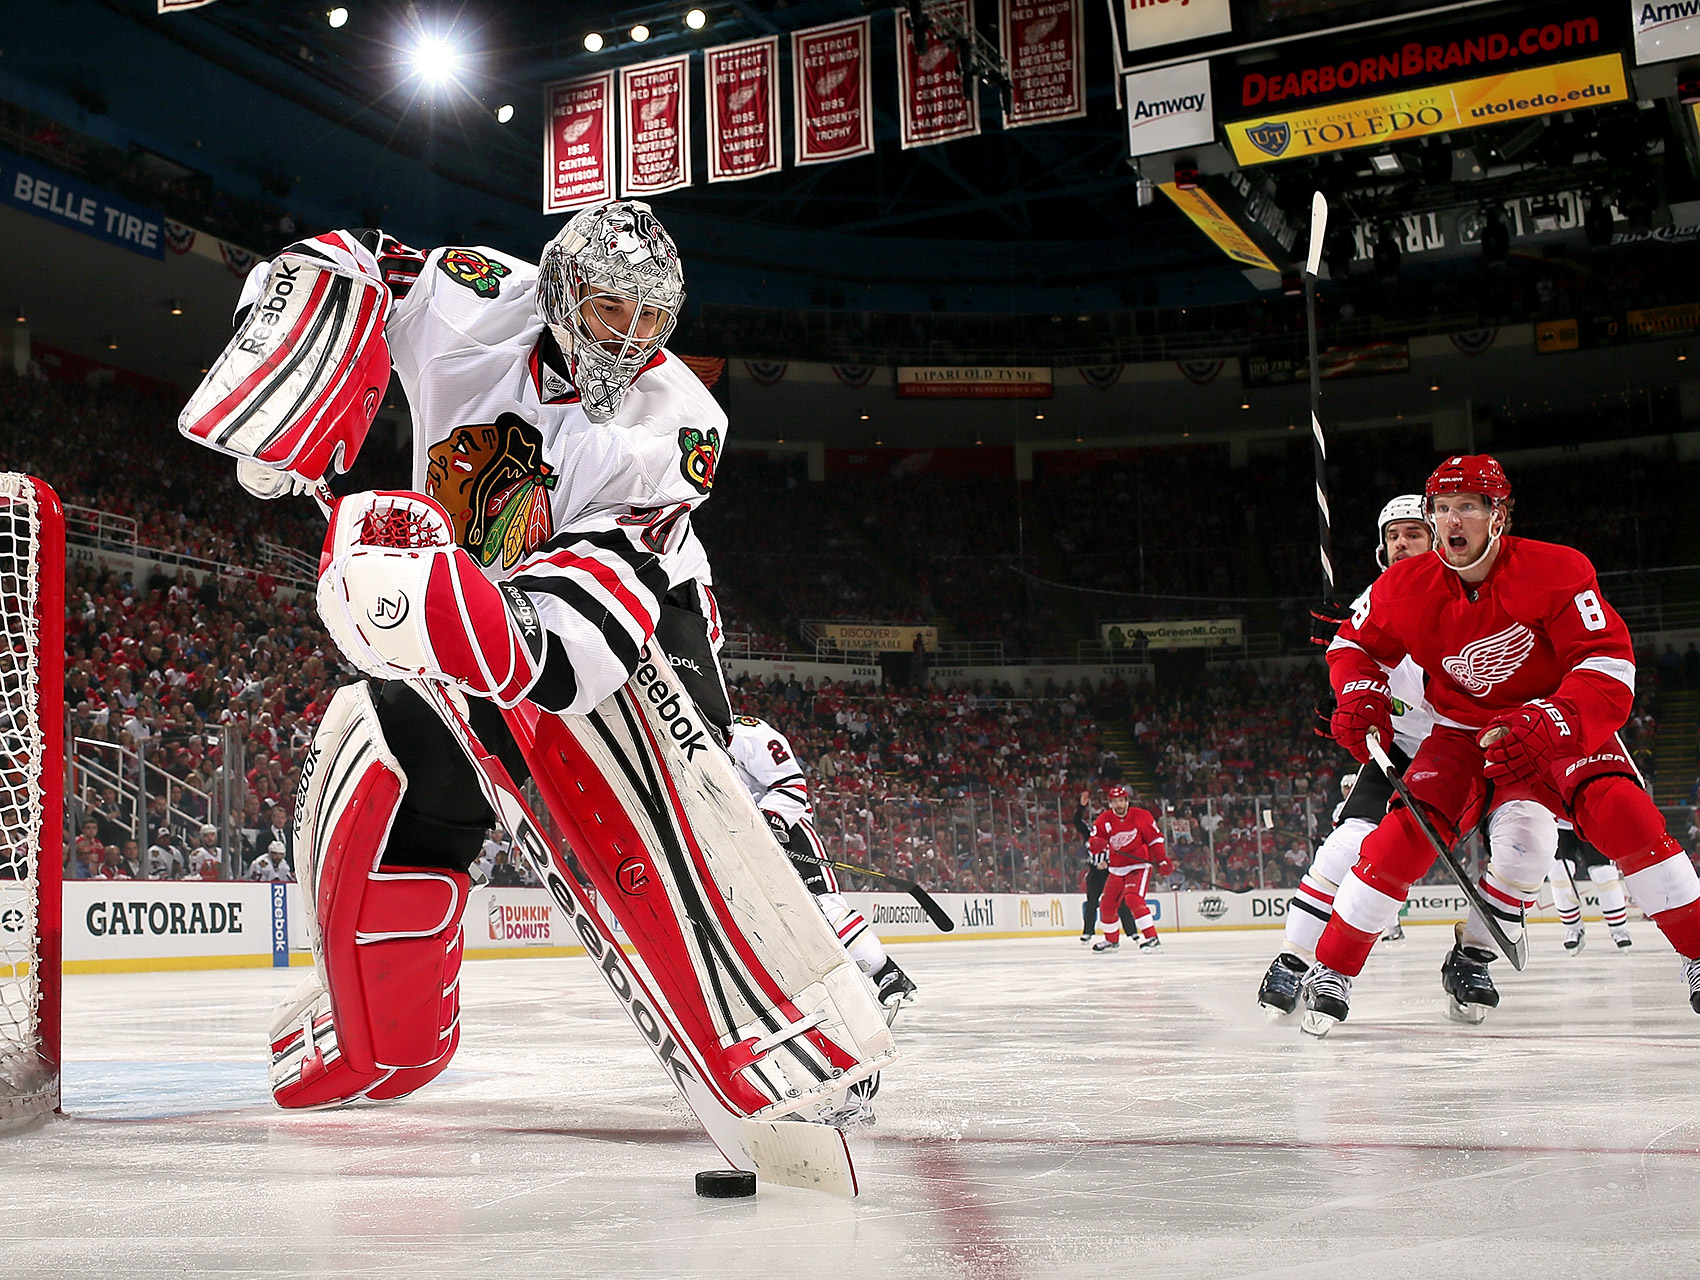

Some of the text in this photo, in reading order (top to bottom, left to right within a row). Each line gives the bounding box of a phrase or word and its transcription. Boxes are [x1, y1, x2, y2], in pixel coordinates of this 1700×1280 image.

[1012, 8, 1034, 21] RED
[1038, 2, 1070, 17] WINGS
[809, 37, 853, 55] DETROIT
[720, 54, 762, 71] DETROIT
[805, 49, 859, 68] RED WINGS
[1019, 51, 1066, 67] WESTERN
[717, 66, 767, 84] RED WINGS
[1012, 61, 1072, 79] CONFERENCE
[634, 71, 674, 88] DETROIT
[1020, 73, 1065, 89] REGULAR
[559, 88, 598, 103] DETROIT
[631, 83, 679, 100] RED WINGS
[916, 86, 960, 101] CENTRAL
[1024, 85, 1064, 100] SEASON
[553, 99, 603, 116] RED WINGS
[821, 98, 845, 110] 1995
[916, 99, 962, 115] DIVISION
[1014, 95, 1073, 113] CHAMPIONS
[1134, 93, 1205, 120] Amway
[1471, 84, 1611, 118] utoledo.edu
[732, 111, 755, 124] 1995
[911, 111, 967, 129] CHAMPIONS
[1294, 97, 1437, 128] THE UNIVERSITY OF
[643, 118, 667, 130] 1995
[723, 123, 764, 139] CLARENCE
[1294, 106, 1443, 146] TOLEDO
[637, 128, 675, 142] WESTERN
[816, 126, 852, 141] TROPHY
[1253, 130, 1284, 145] UT
[567, 144, 590, 156] 1995
[723, 138, 763, 153] CAMPBELL
[559, 155, 597, 171] CENTRAL
[733, 153, 755, 165] BOWL
[559, 168, 599, 184] DIVISION
[555, 181, 605, 197] CHAMPIONS
[14, 172, 158, 248] BELLE TIRE
[238, 262, 301, 355] Reebok
[915, 369, 1035, 382] LIPARI OLD TYME
[502, 584, 537, 638] Reebok
[1574, 589, 1606, 632] 8
[840, 628, 891, 639] DISCOVER
[667, 654, 704, 677] bok
[1342, 680, 1392, 699] BAUE
[767, 739, 791, 766] 2
[1565, 753, 1626, 777] BAUER
[86, 901, 243, 937] GATORADE
[273, 884, 285, 951] Reebok
[505, 906, 552, 922] DUNKIN'
[961, 898, 994, 927] Advil
[506, 923, 550, 939] DONUTS
